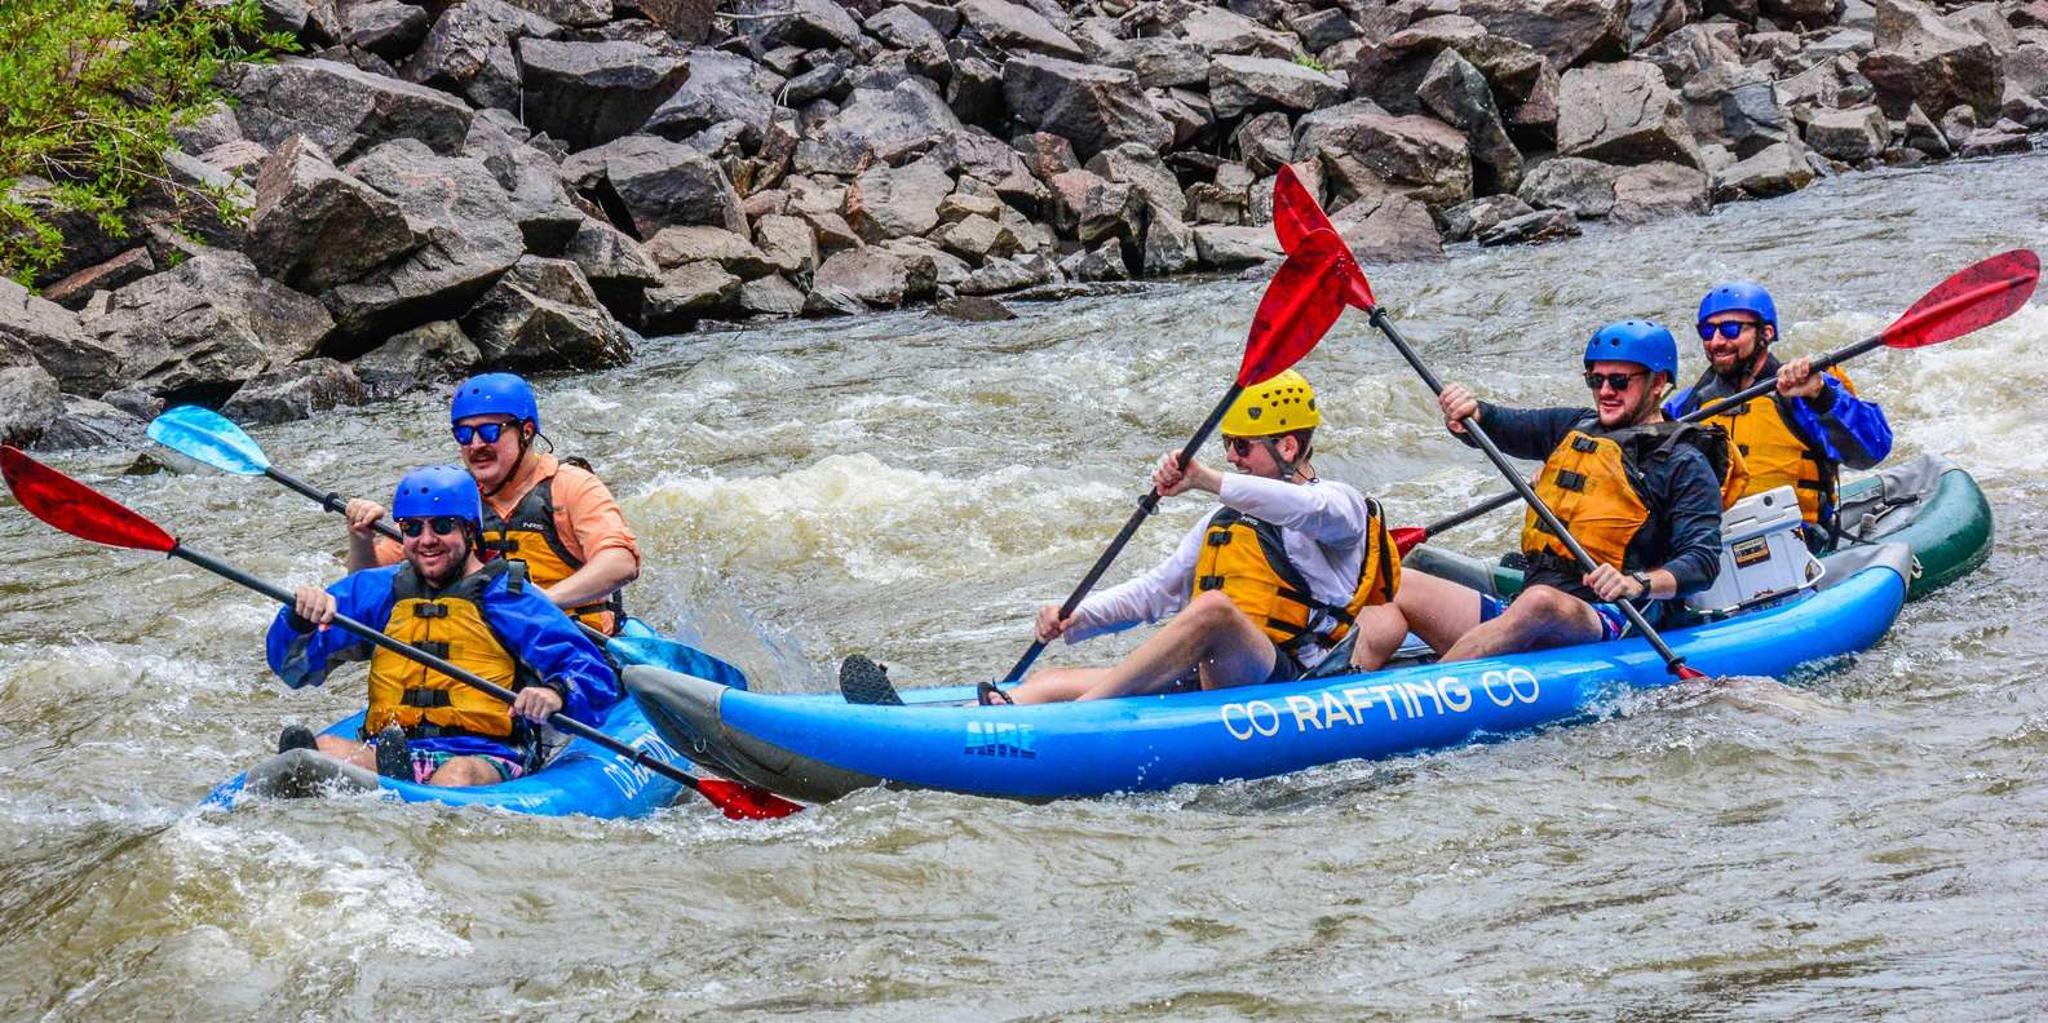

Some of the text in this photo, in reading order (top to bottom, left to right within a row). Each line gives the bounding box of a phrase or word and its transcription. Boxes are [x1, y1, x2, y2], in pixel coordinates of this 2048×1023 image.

[1221, 667, 1540, 741] CO RAFTING CO
